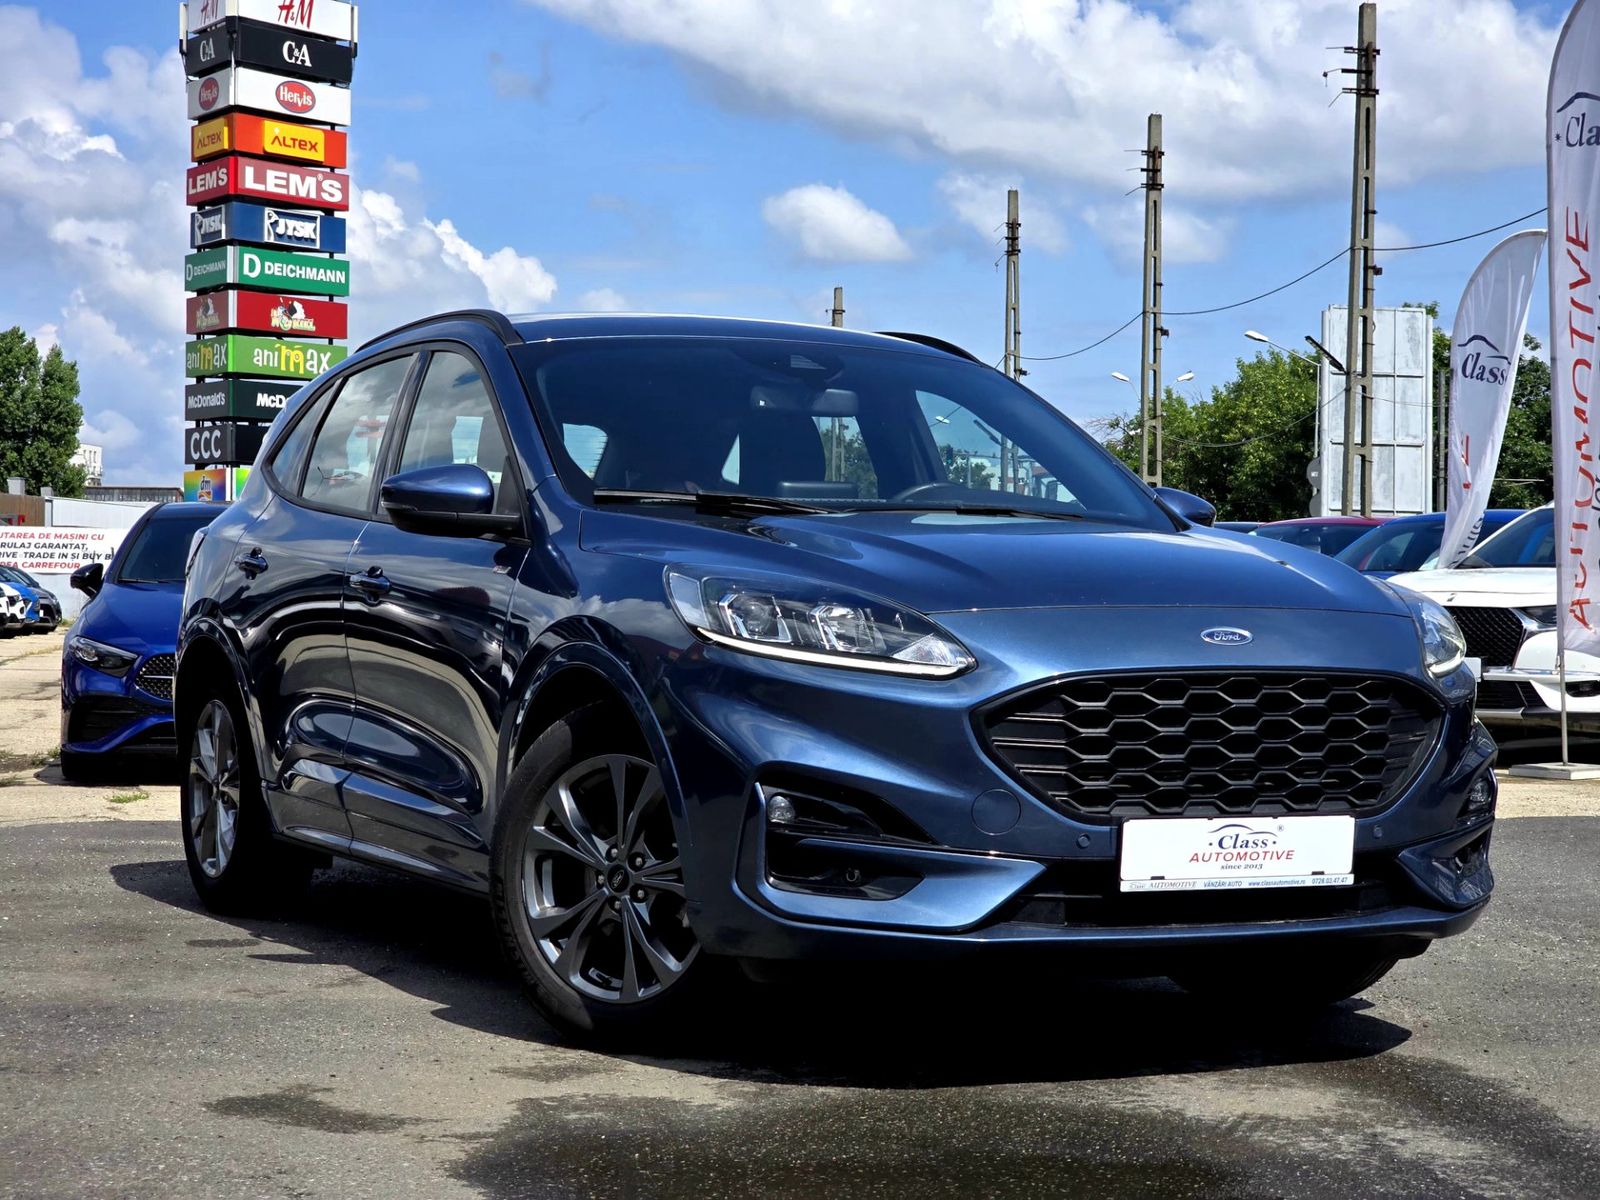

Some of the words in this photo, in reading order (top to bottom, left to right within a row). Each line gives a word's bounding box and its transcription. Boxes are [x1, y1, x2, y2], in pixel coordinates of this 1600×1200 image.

[277, 0, 315, 29] H&M
[282, 40, 313, 68] C&A
[279, 86, 313, 107] Hervis
[188, 166, 228, 195] LEM'S
[201, 214, 222, 234] JYSK
[275, 218, 317, 241] JYSK
[193, 260, 226, 276] DEICHMANN
[264, 261, 346, 284] DEICHMANN
[186, 342, 227, 370] animax
[253, 344, 332, 375] animax
[187, 392, 226, 409] McDonald's
[256, 392, 287, 409] McD
[190, 429, 222, 461] CCC
[0, 541, 31, 549] RULAJ
[38, 532, 51, 540] DE
[90, 533, 105, 541] CU
[24, 551, 56, 559] TRADE
[58, 552, 69, 560] IN
[82, 552, 103, 560] BUY
[21, 561, 81, 569] CARREFOUR
[1218, 833, 1269, 850] Class
[1189, 849, 1295, 863] AUTOMOTIVE
[1150, 880, 1197, 889] AUTOMOTIVE
